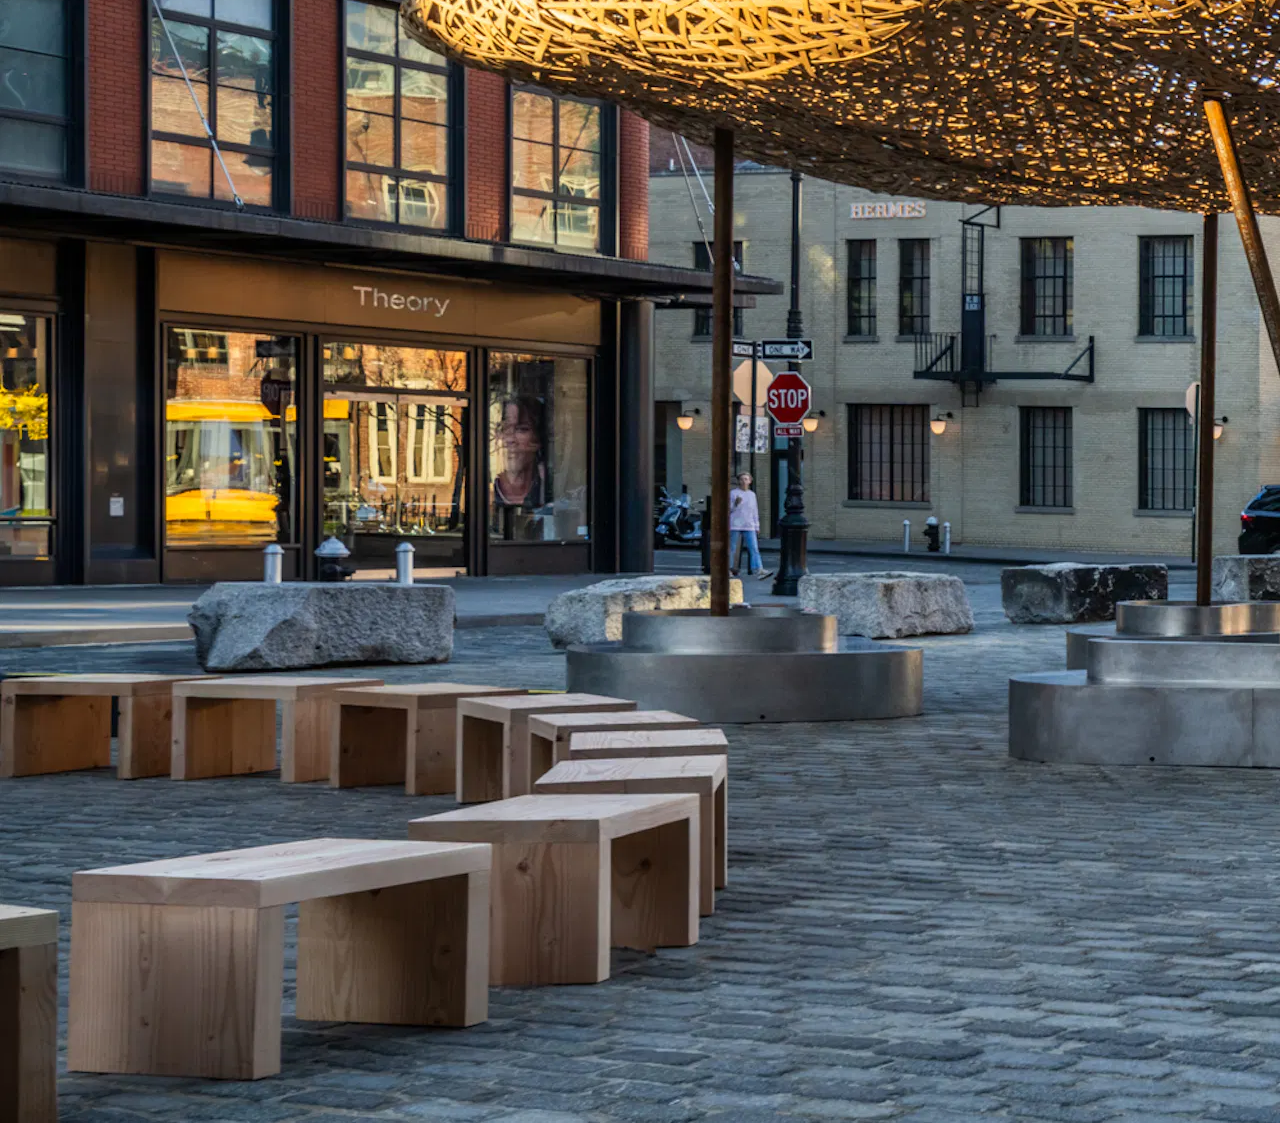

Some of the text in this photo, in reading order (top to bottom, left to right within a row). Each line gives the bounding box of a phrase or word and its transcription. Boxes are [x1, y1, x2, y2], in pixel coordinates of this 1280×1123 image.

[352, 285, 450, 318] Theory
[768, 345, 806, 355] ONE WAY
[768, 388, 808, 409] STOP
